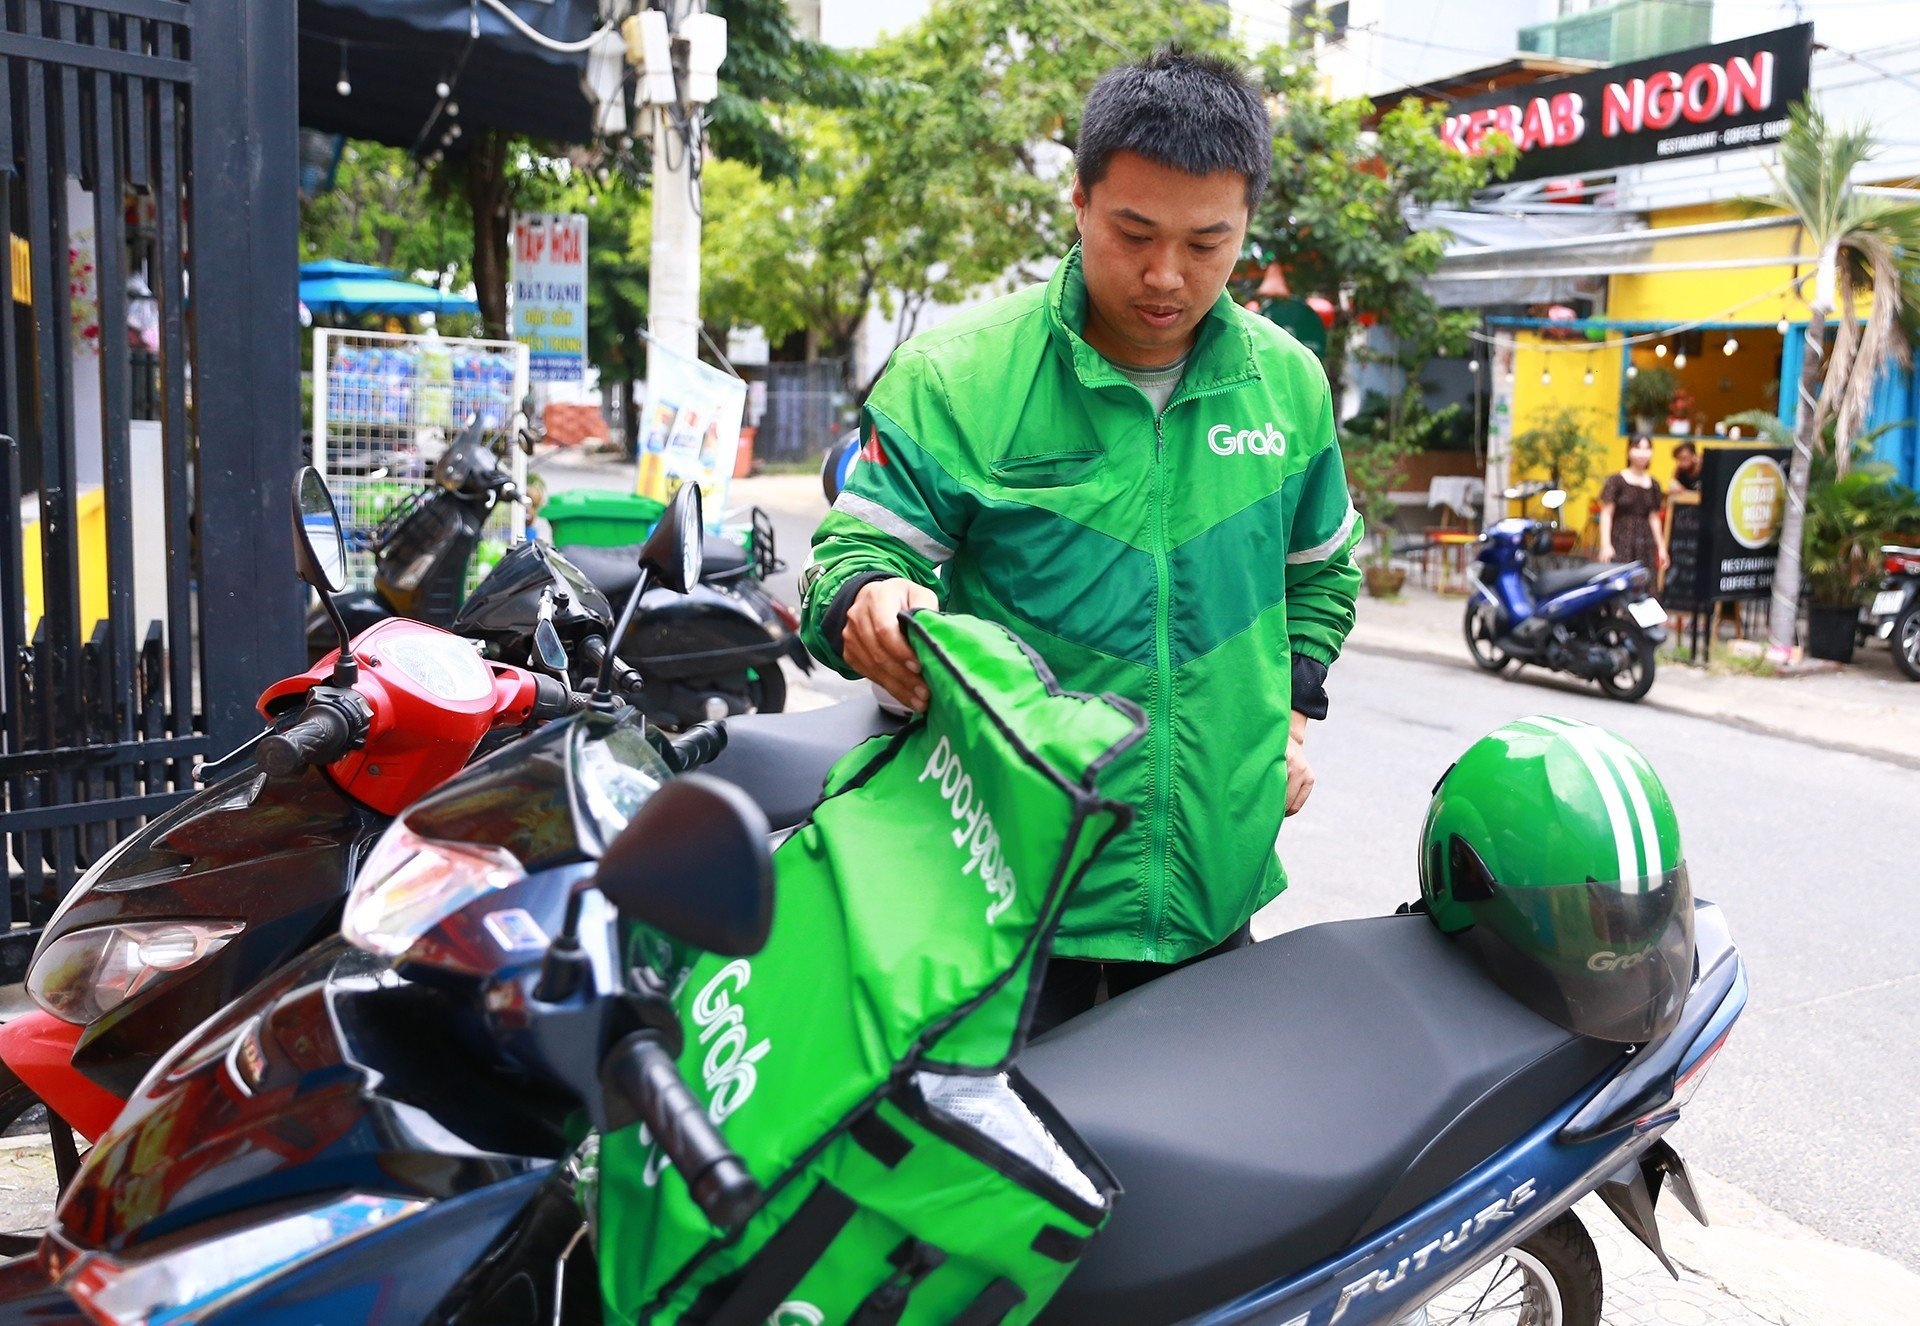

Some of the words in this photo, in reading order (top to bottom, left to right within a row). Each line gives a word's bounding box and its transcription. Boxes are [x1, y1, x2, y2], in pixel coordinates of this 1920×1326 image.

[1441, 92, 1585, 156] KEBAB
[1602, 51, 1774, 138] NGON
[1656, 130, 1719, 155] RESTAURANT
[1723, 123, 1762, 145] COFFEE
[1207, 422, 1286, 456] Grab
[1719, 576, 1757, 592] COFFEE
[1720, 557, 1778, 574] RESTAURAN
[918, 735, 1017, 926] GrabFood
[692, 958, 772, 1126] Grab
[1328, 1177, 1537, 1326] FUTURE
